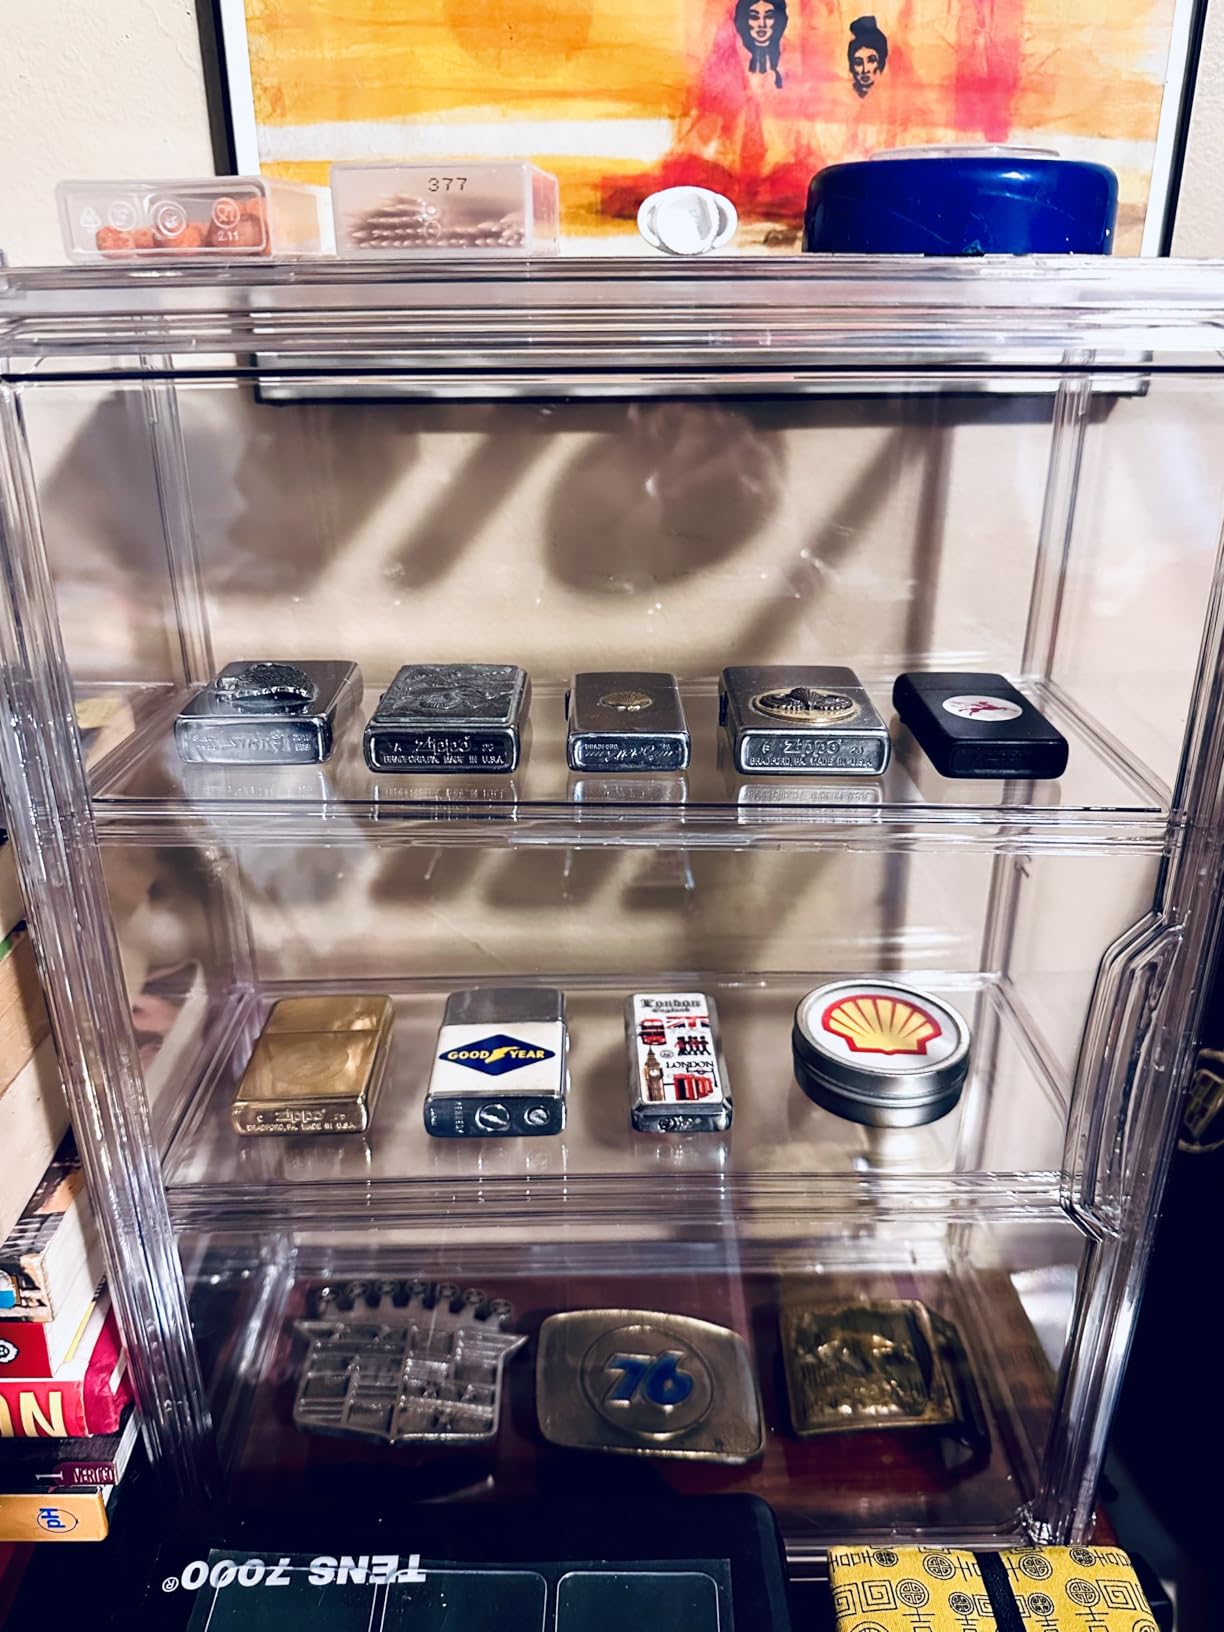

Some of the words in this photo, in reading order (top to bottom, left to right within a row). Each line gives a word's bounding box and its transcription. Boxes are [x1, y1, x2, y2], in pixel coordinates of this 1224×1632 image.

[427, 177, 467, 192] 377
[783, 739, 842, 757] Zippo
[447, 1050, 490, 1060] GOOD
[510, 1050, 545, 1059] YEAR
[666, 1060, 714, 1069] LONDON
[603, 1350, 693, 1409] 76
[308, 1554, 427, 1585] TENS
